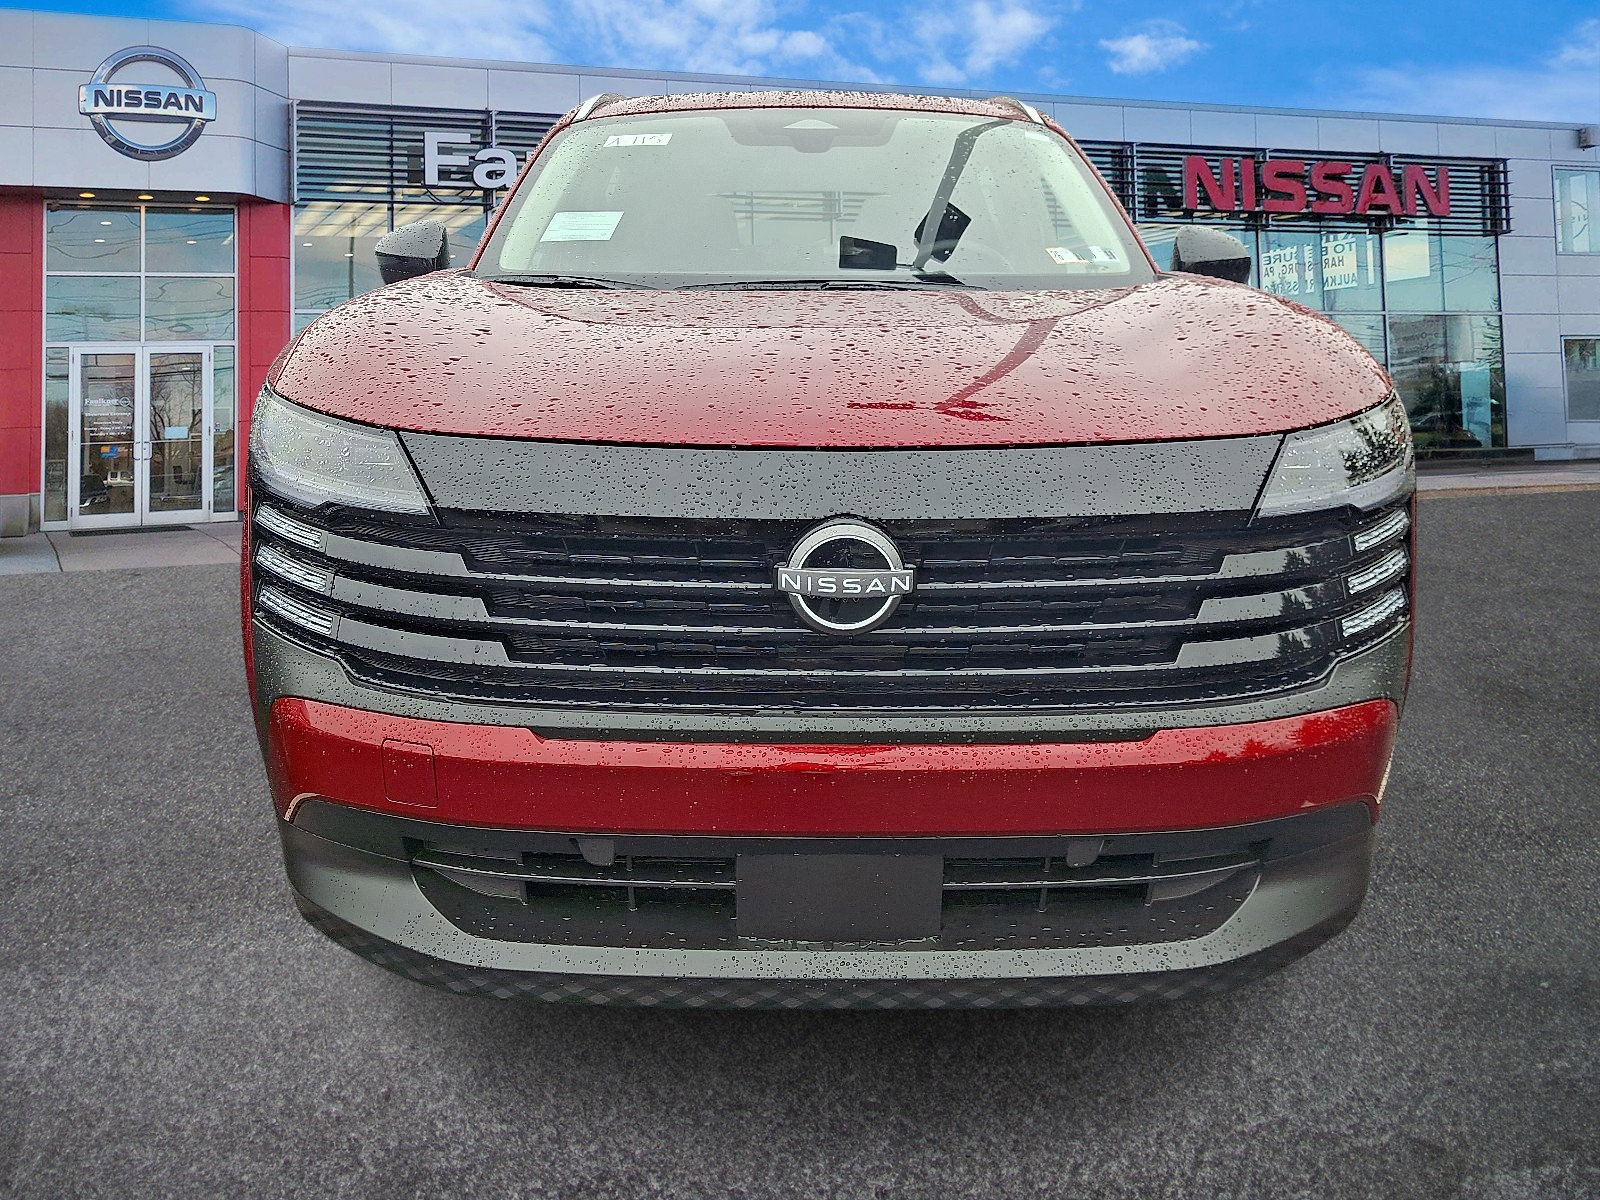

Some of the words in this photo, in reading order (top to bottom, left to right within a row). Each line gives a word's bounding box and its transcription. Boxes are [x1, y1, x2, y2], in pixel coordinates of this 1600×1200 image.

[94, 89, 203, 113] NISSAN
[424, 131, 532, 189] Fa
[1183, 155, 1450, 217] NISSAN
[780, 573, 910, 594] NISSAN
